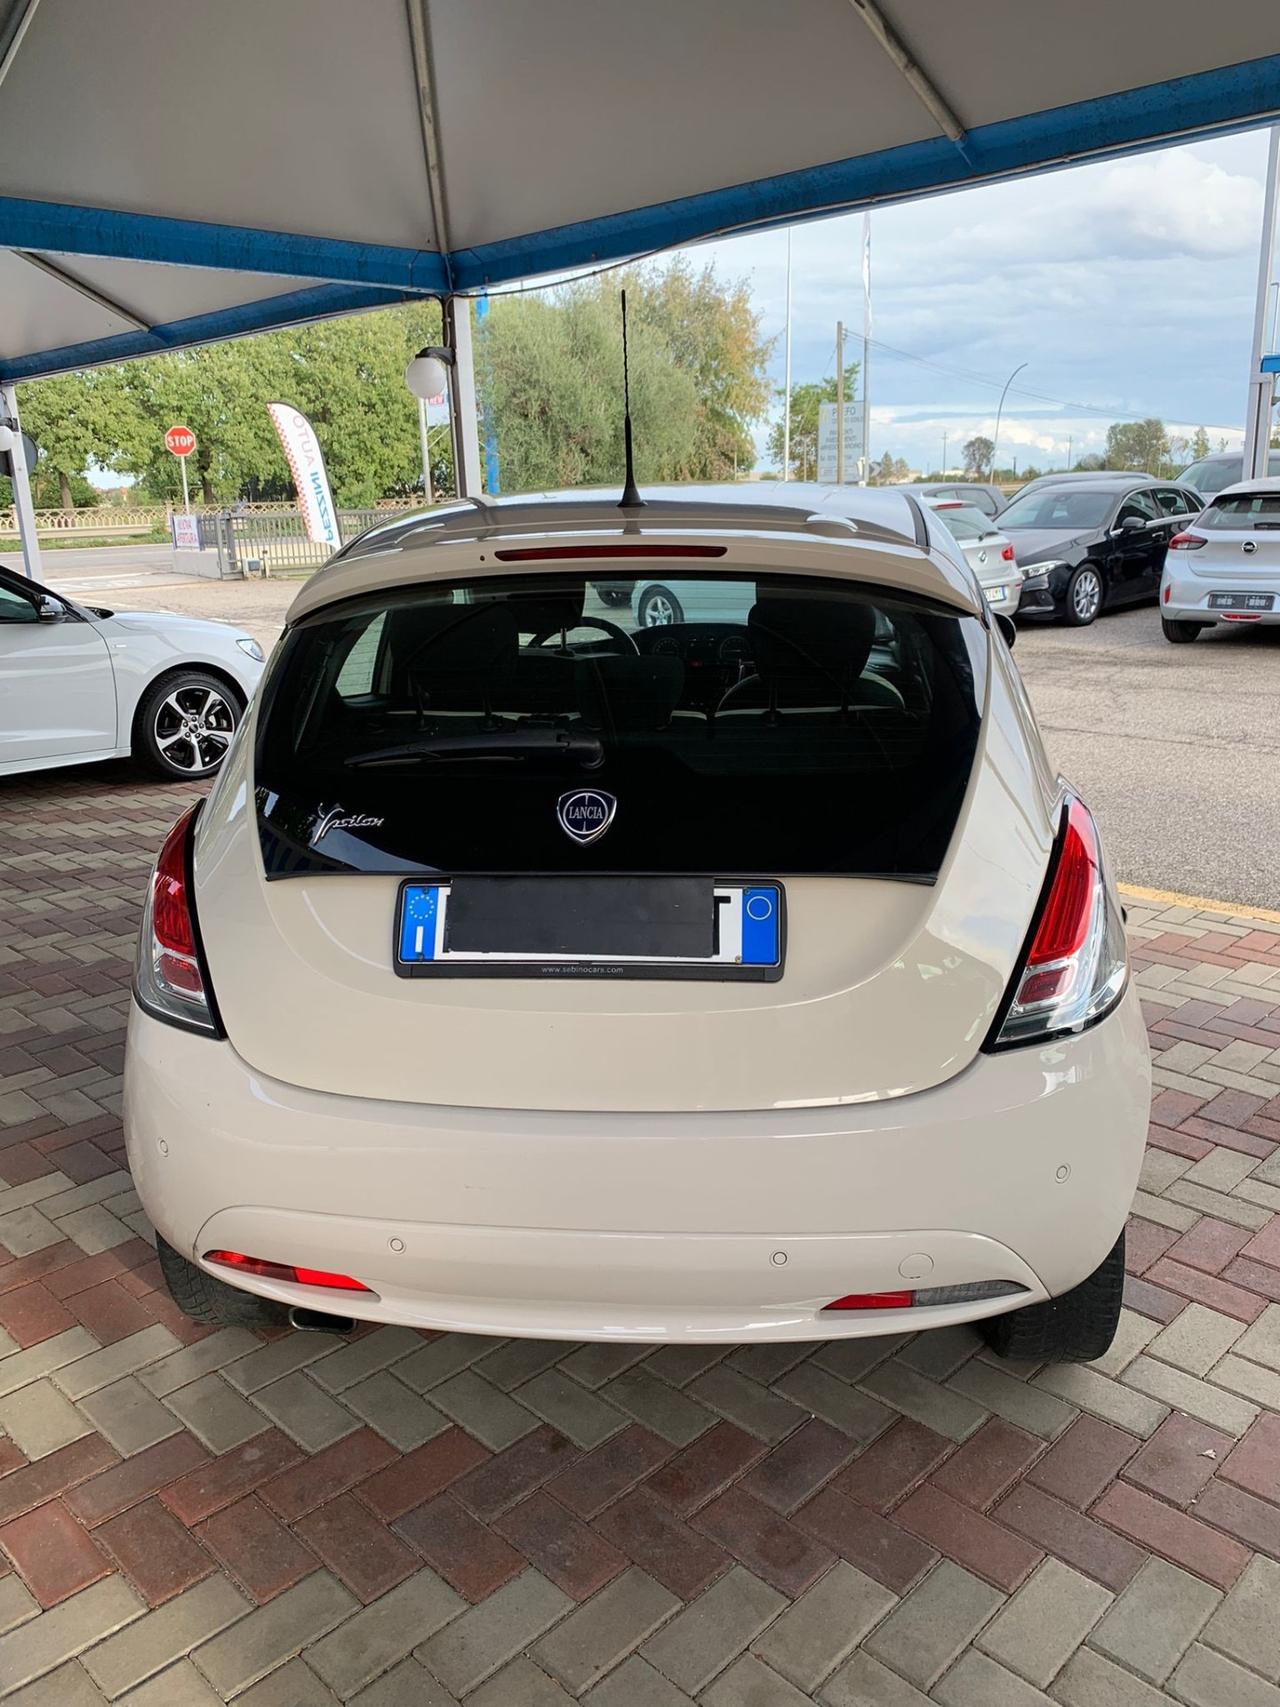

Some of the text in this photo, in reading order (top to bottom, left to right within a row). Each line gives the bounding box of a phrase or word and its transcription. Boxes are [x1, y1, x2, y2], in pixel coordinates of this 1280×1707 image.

[167, 435, 193, 447] STOP
[568, 806, 603, 819] LANCIA
[313, 803, 385, 844] Ypsilon
[415, 925, 423, 952] I
